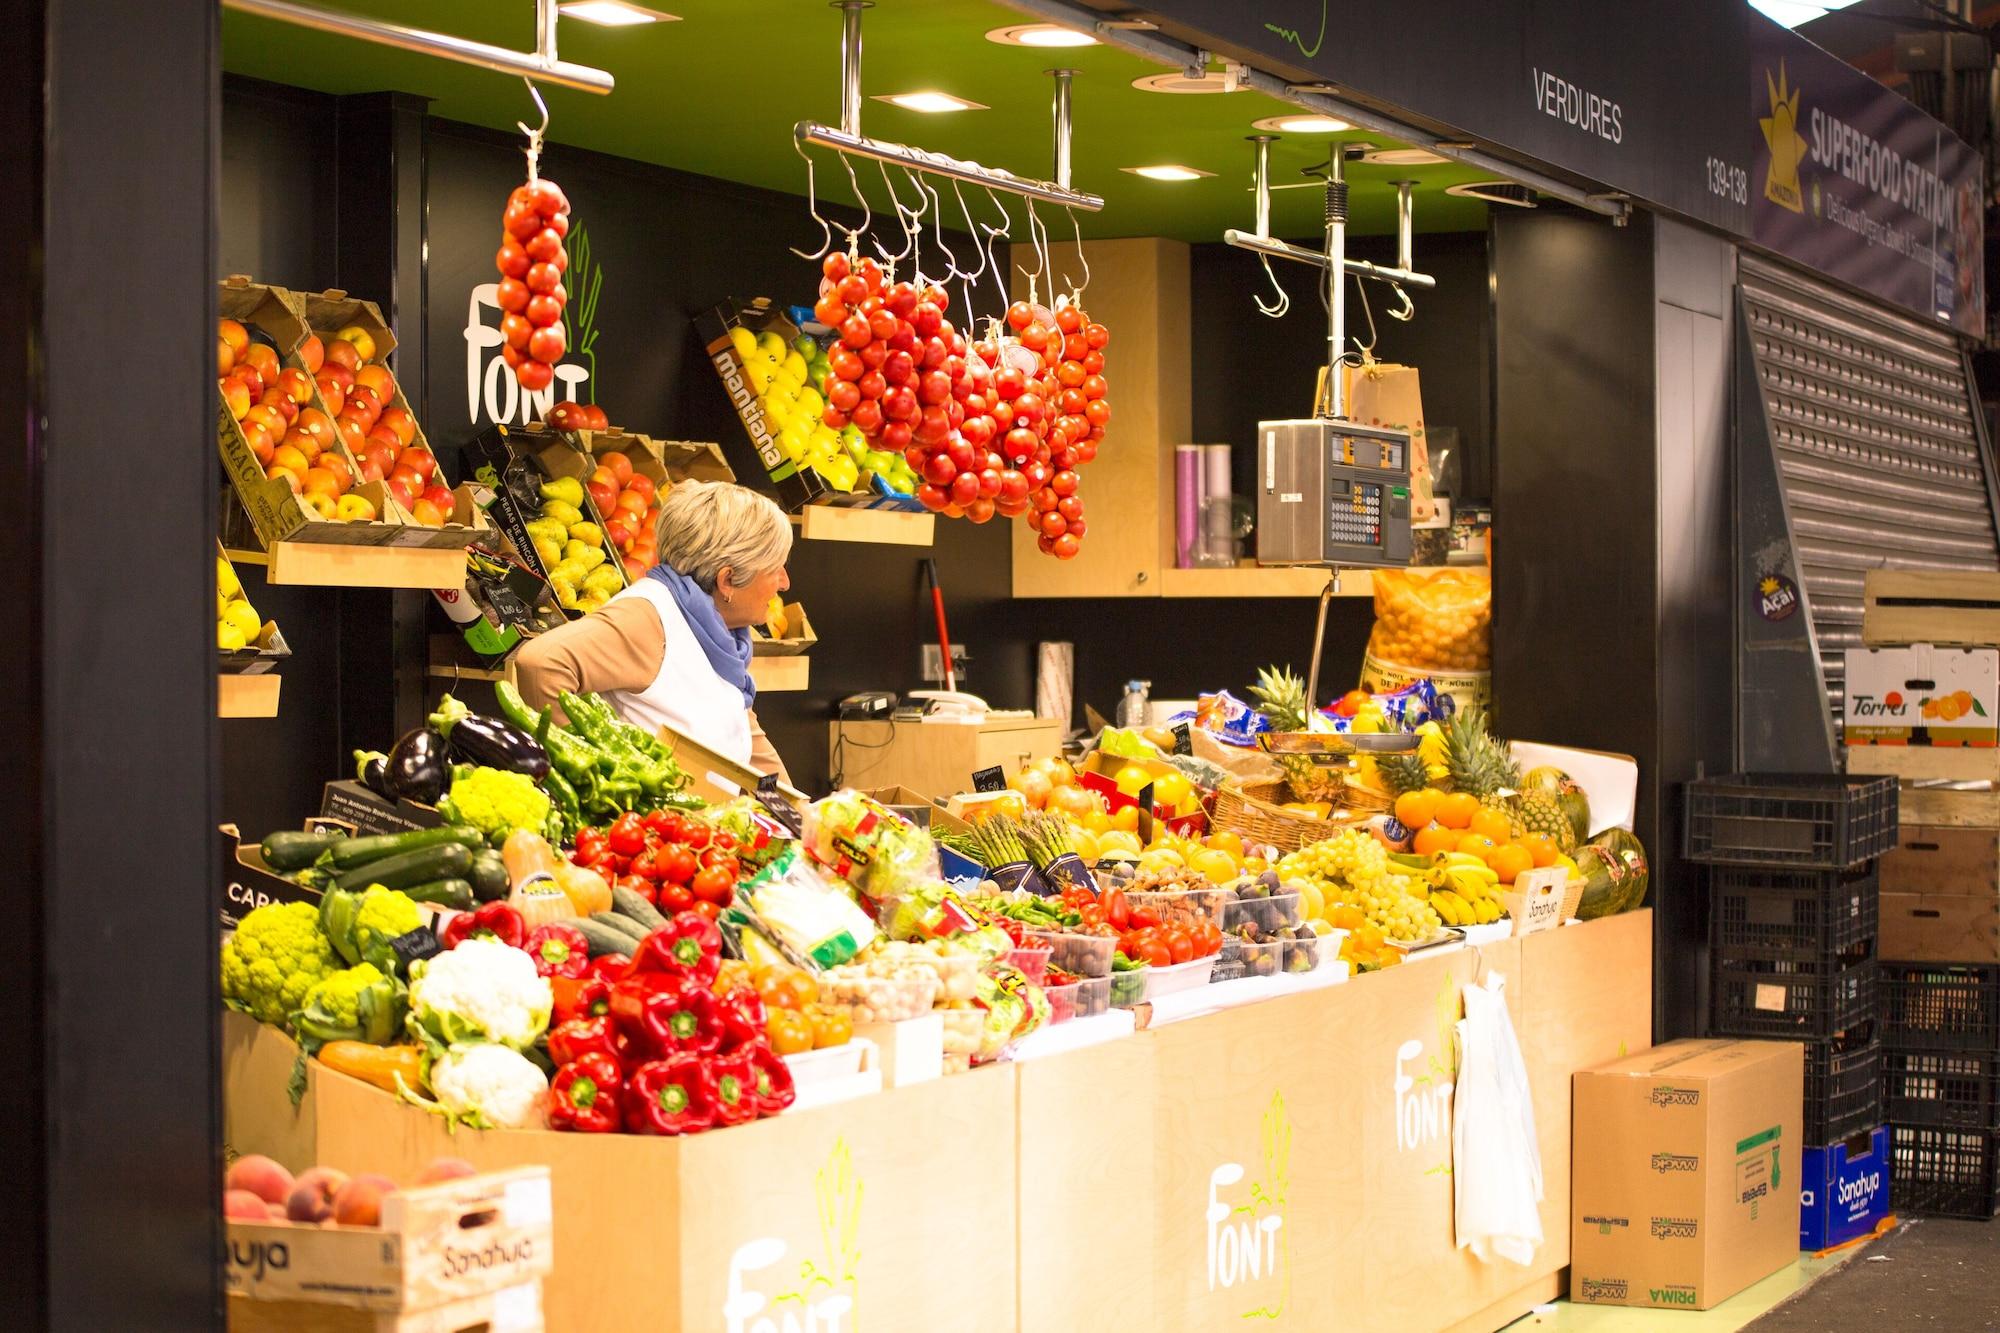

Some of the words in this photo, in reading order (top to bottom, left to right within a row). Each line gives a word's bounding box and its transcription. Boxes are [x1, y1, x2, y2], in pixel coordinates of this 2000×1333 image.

[1533, 67, 1622, 144] VERDURES
[1811, 106, 1901, 203] SUPERFOOD
[1706, 156, 1748, 206] 139-138
[716, 351, 782, 468] mantiana
[500, 496, 516, 523] PERAS
[512, 523, 522, 536] DE
[1853, 695, 1908, 716] Torres
[332, 793, 348, 805] Juan
[347, 798, 372, 814] Antonio
[1393, 1039, 1455, 1152] FONT
[1838, 1170, 1880, 1205] Sanahuja
[1206, 1162, 1283, 1293] FONT
[226, 1238, 289, 1282] uja
[1649, 1288, 1696, 1304] PRIMA
